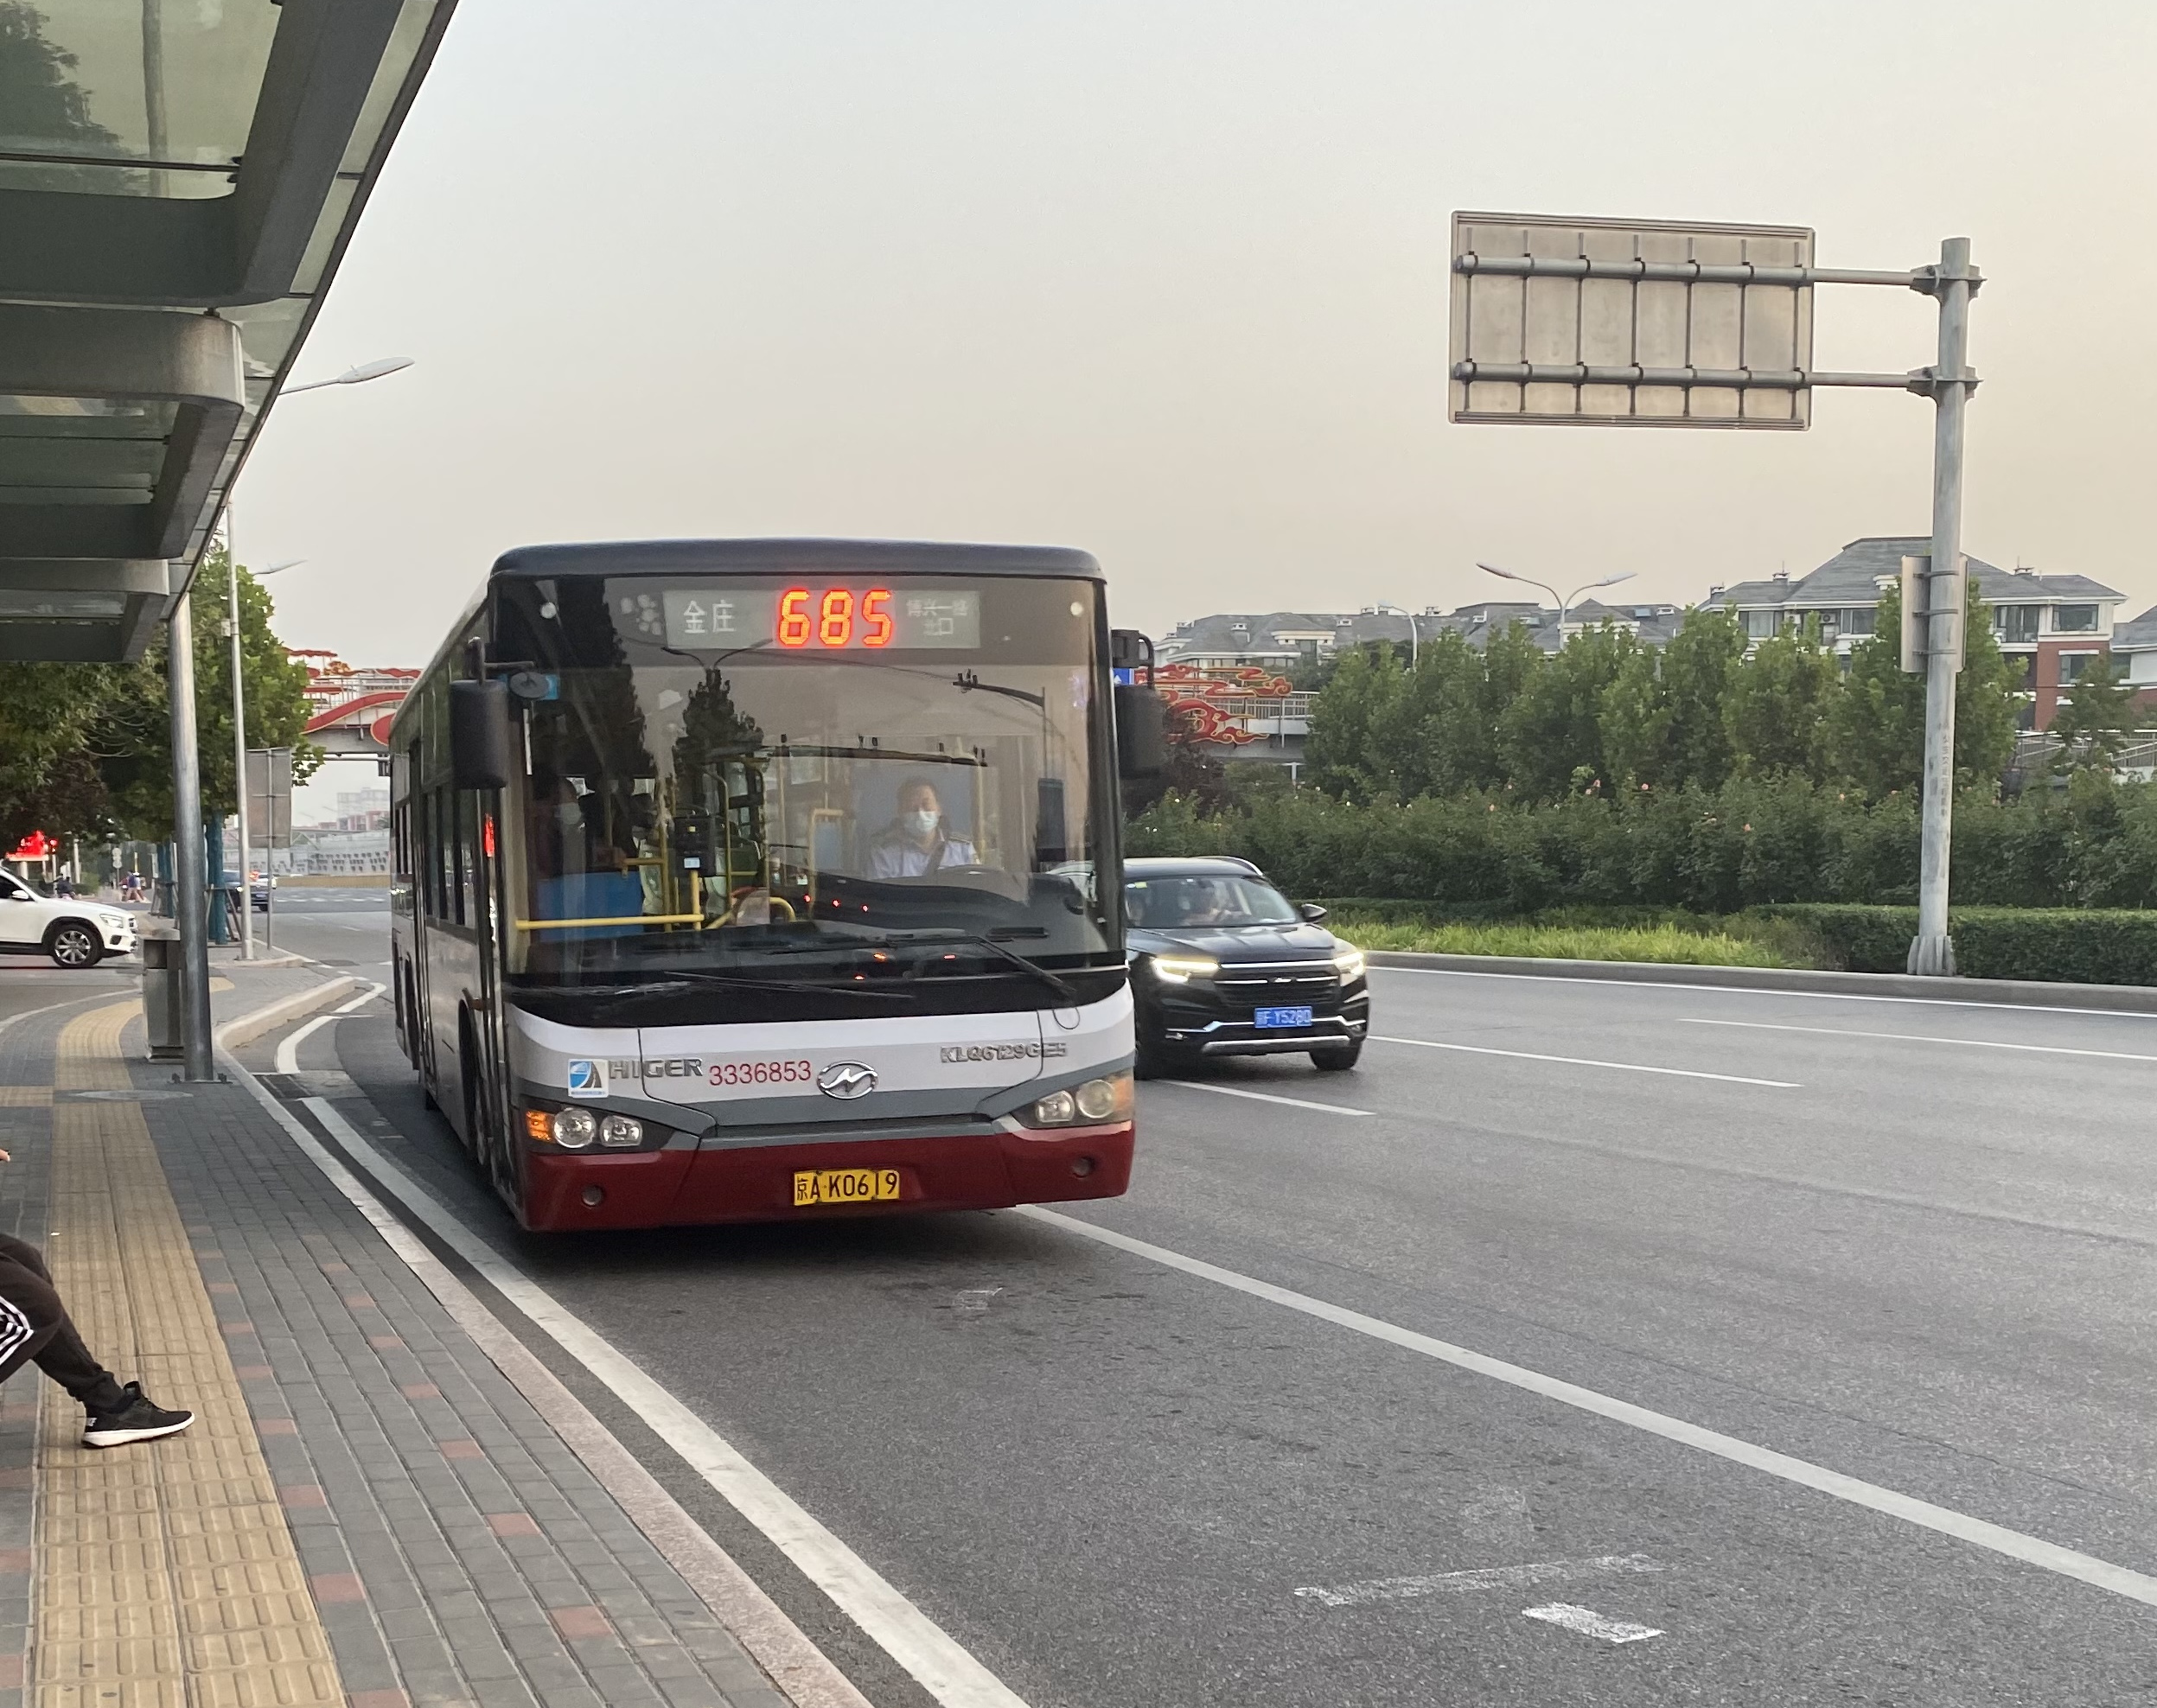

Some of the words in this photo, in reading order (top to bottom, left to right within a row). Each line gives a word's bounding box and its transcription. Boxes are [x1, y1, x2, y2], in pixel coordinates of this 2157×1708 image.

[683, 600, 735, 634] 金庄
[779, 590, 892, 646] 685
[609, 1058, 703, 1079] HIGER
[709, 1061, 811, 1086] 3336853
